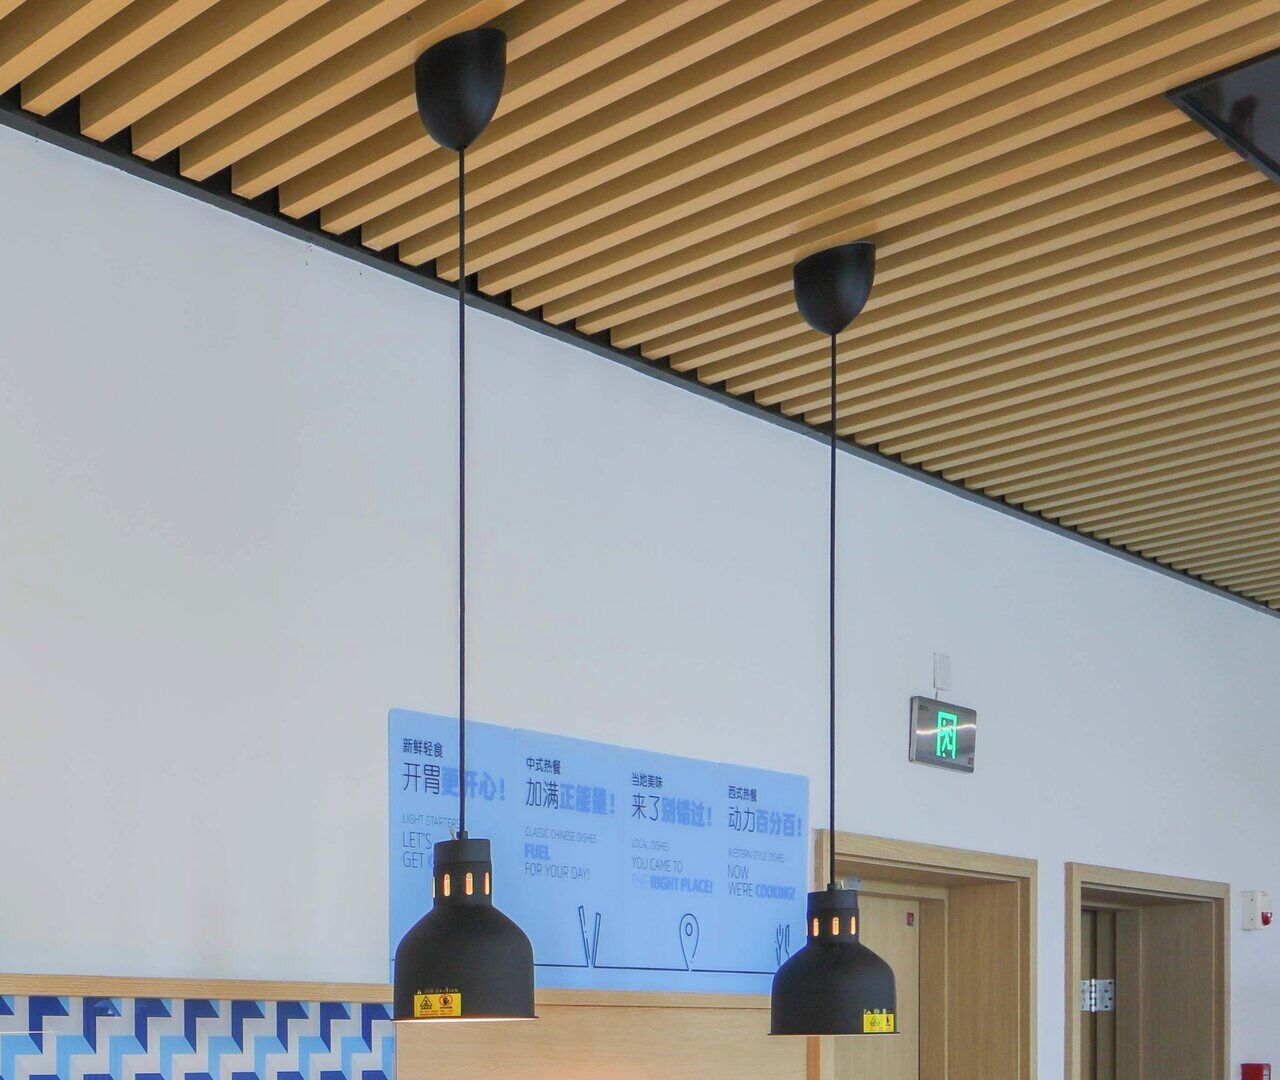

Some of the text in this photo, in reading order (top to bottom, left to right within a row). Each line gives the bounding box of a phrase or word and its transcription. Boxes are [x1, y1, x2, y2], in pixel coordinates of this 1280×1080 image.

[403, 738, 443, 758] 新鲜轻食
[526, 756, 561, 775] 中式热餐
[632, 772, 663, 788] 当地美味
[729, 786, 757, 802] 西式热餐
[402, 814, 424, 824] LIGHT
[403, 831, 432, 850] LET'S
[403, 851, 424, 868] GET
[524, 843, 551, 860] FUEL
[525, 862, 543, 876] FOR
[545, 864, 569, 879] YOUR
[632, 856, 683, 873] YOU CAME TO
[728, 864, 750, 879] NOW
[650, 874, 680, 891] RIGHT
[681, 877, 714, 894] PLACE!
[755, 883, 796, 900] COOKING!
